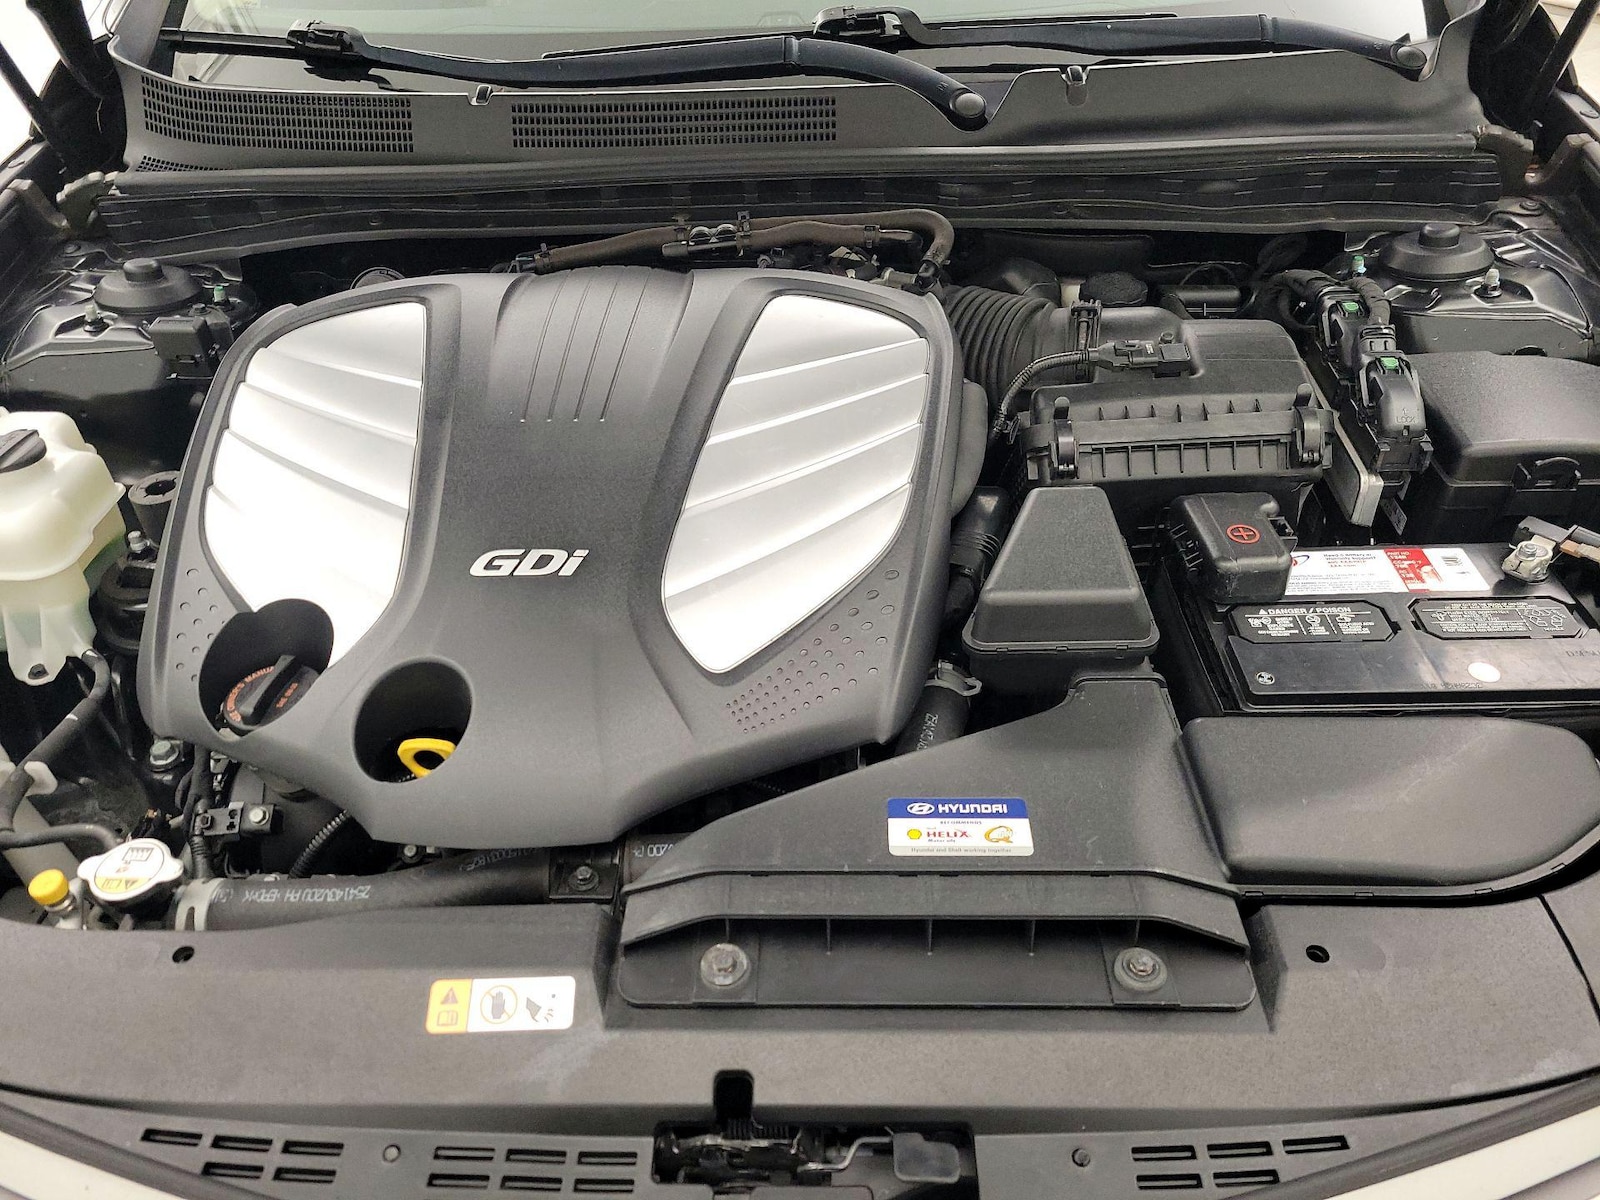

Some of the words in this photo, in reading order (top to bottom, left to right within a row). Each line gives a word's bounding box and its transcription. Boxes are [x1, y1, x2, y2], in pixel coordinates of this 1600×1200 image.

[469, 549, 590, 578] GDi
[1267, 607, 1308, 615] DANGER
[1315, 606, 1351, 614] POISON
[937, 803, 1009, 815] HYUNDAI
[926, 830, 970, 838] HELIX
